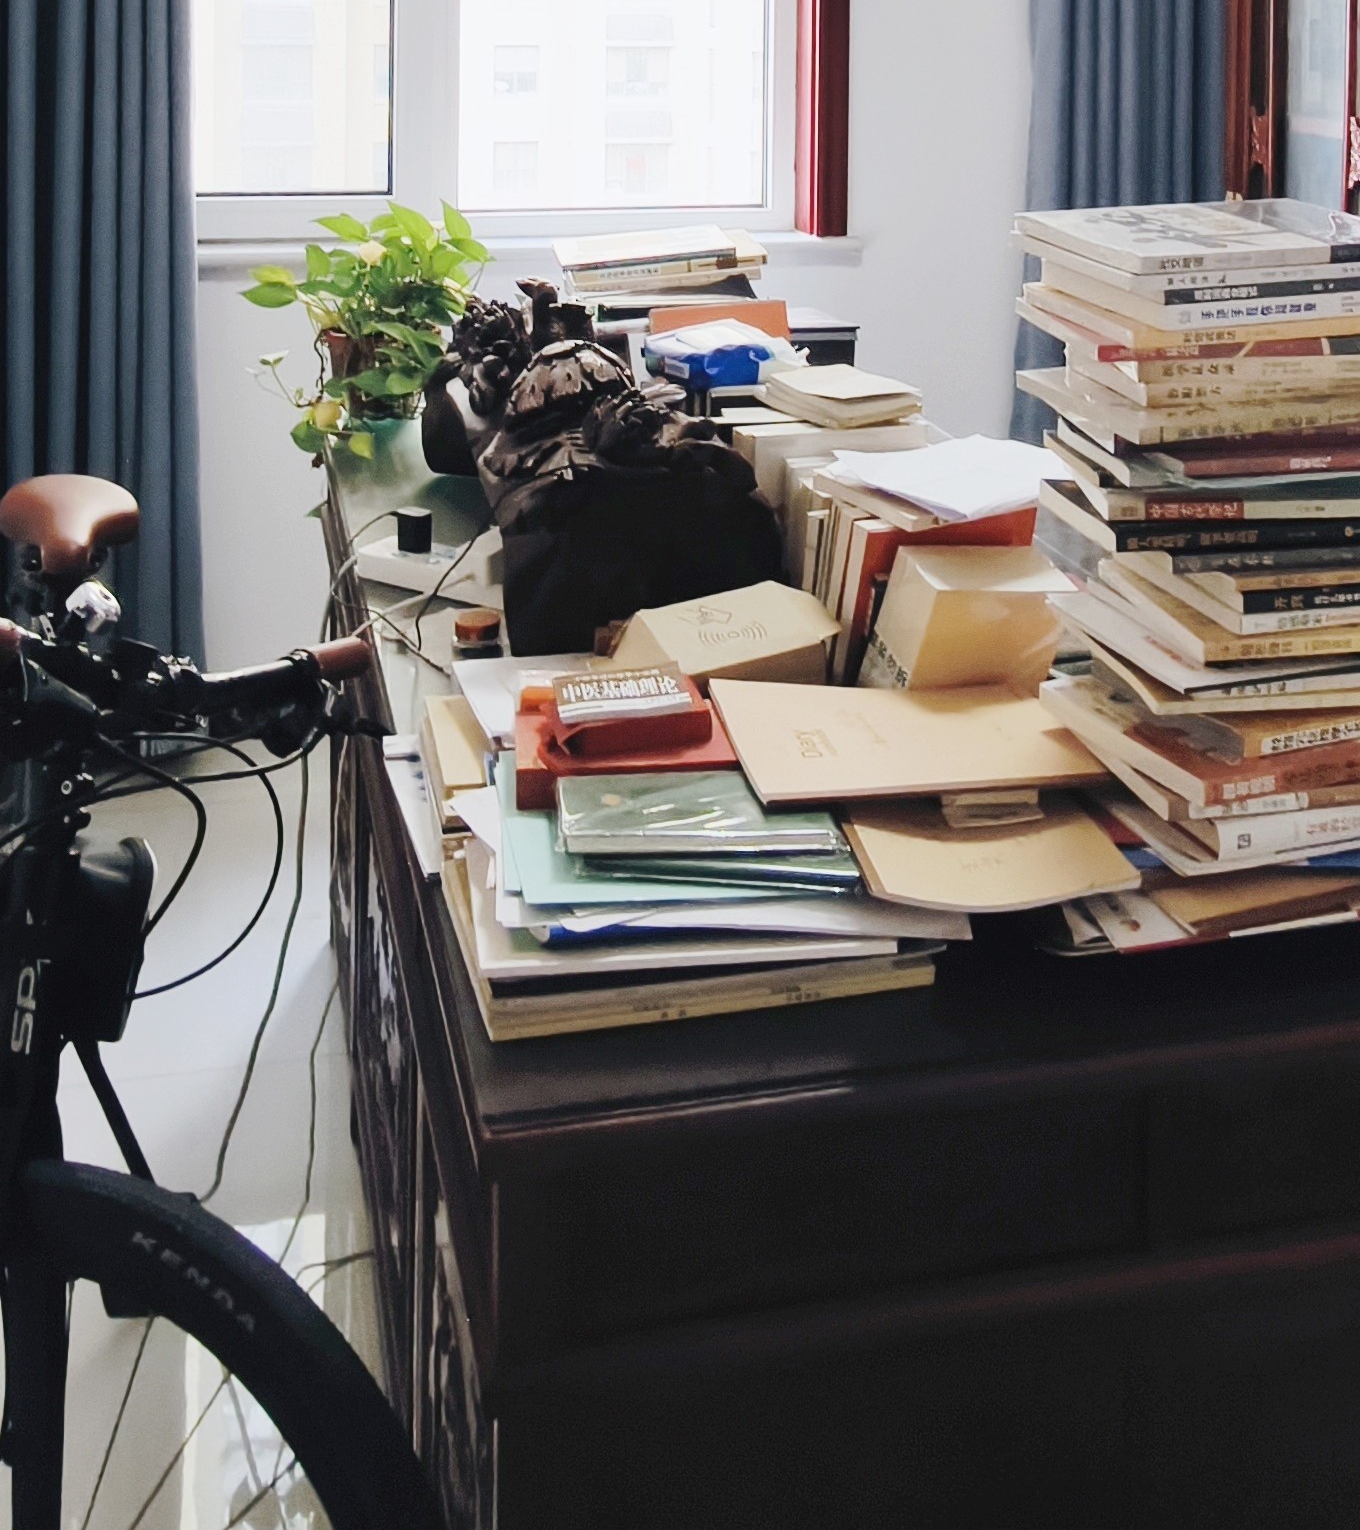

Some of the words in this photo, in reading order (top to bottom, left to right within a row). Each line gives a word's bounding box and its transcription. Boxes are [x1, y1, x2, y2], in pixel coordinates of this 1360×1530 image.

[562, 675, 680, 702] 中医基础理论
